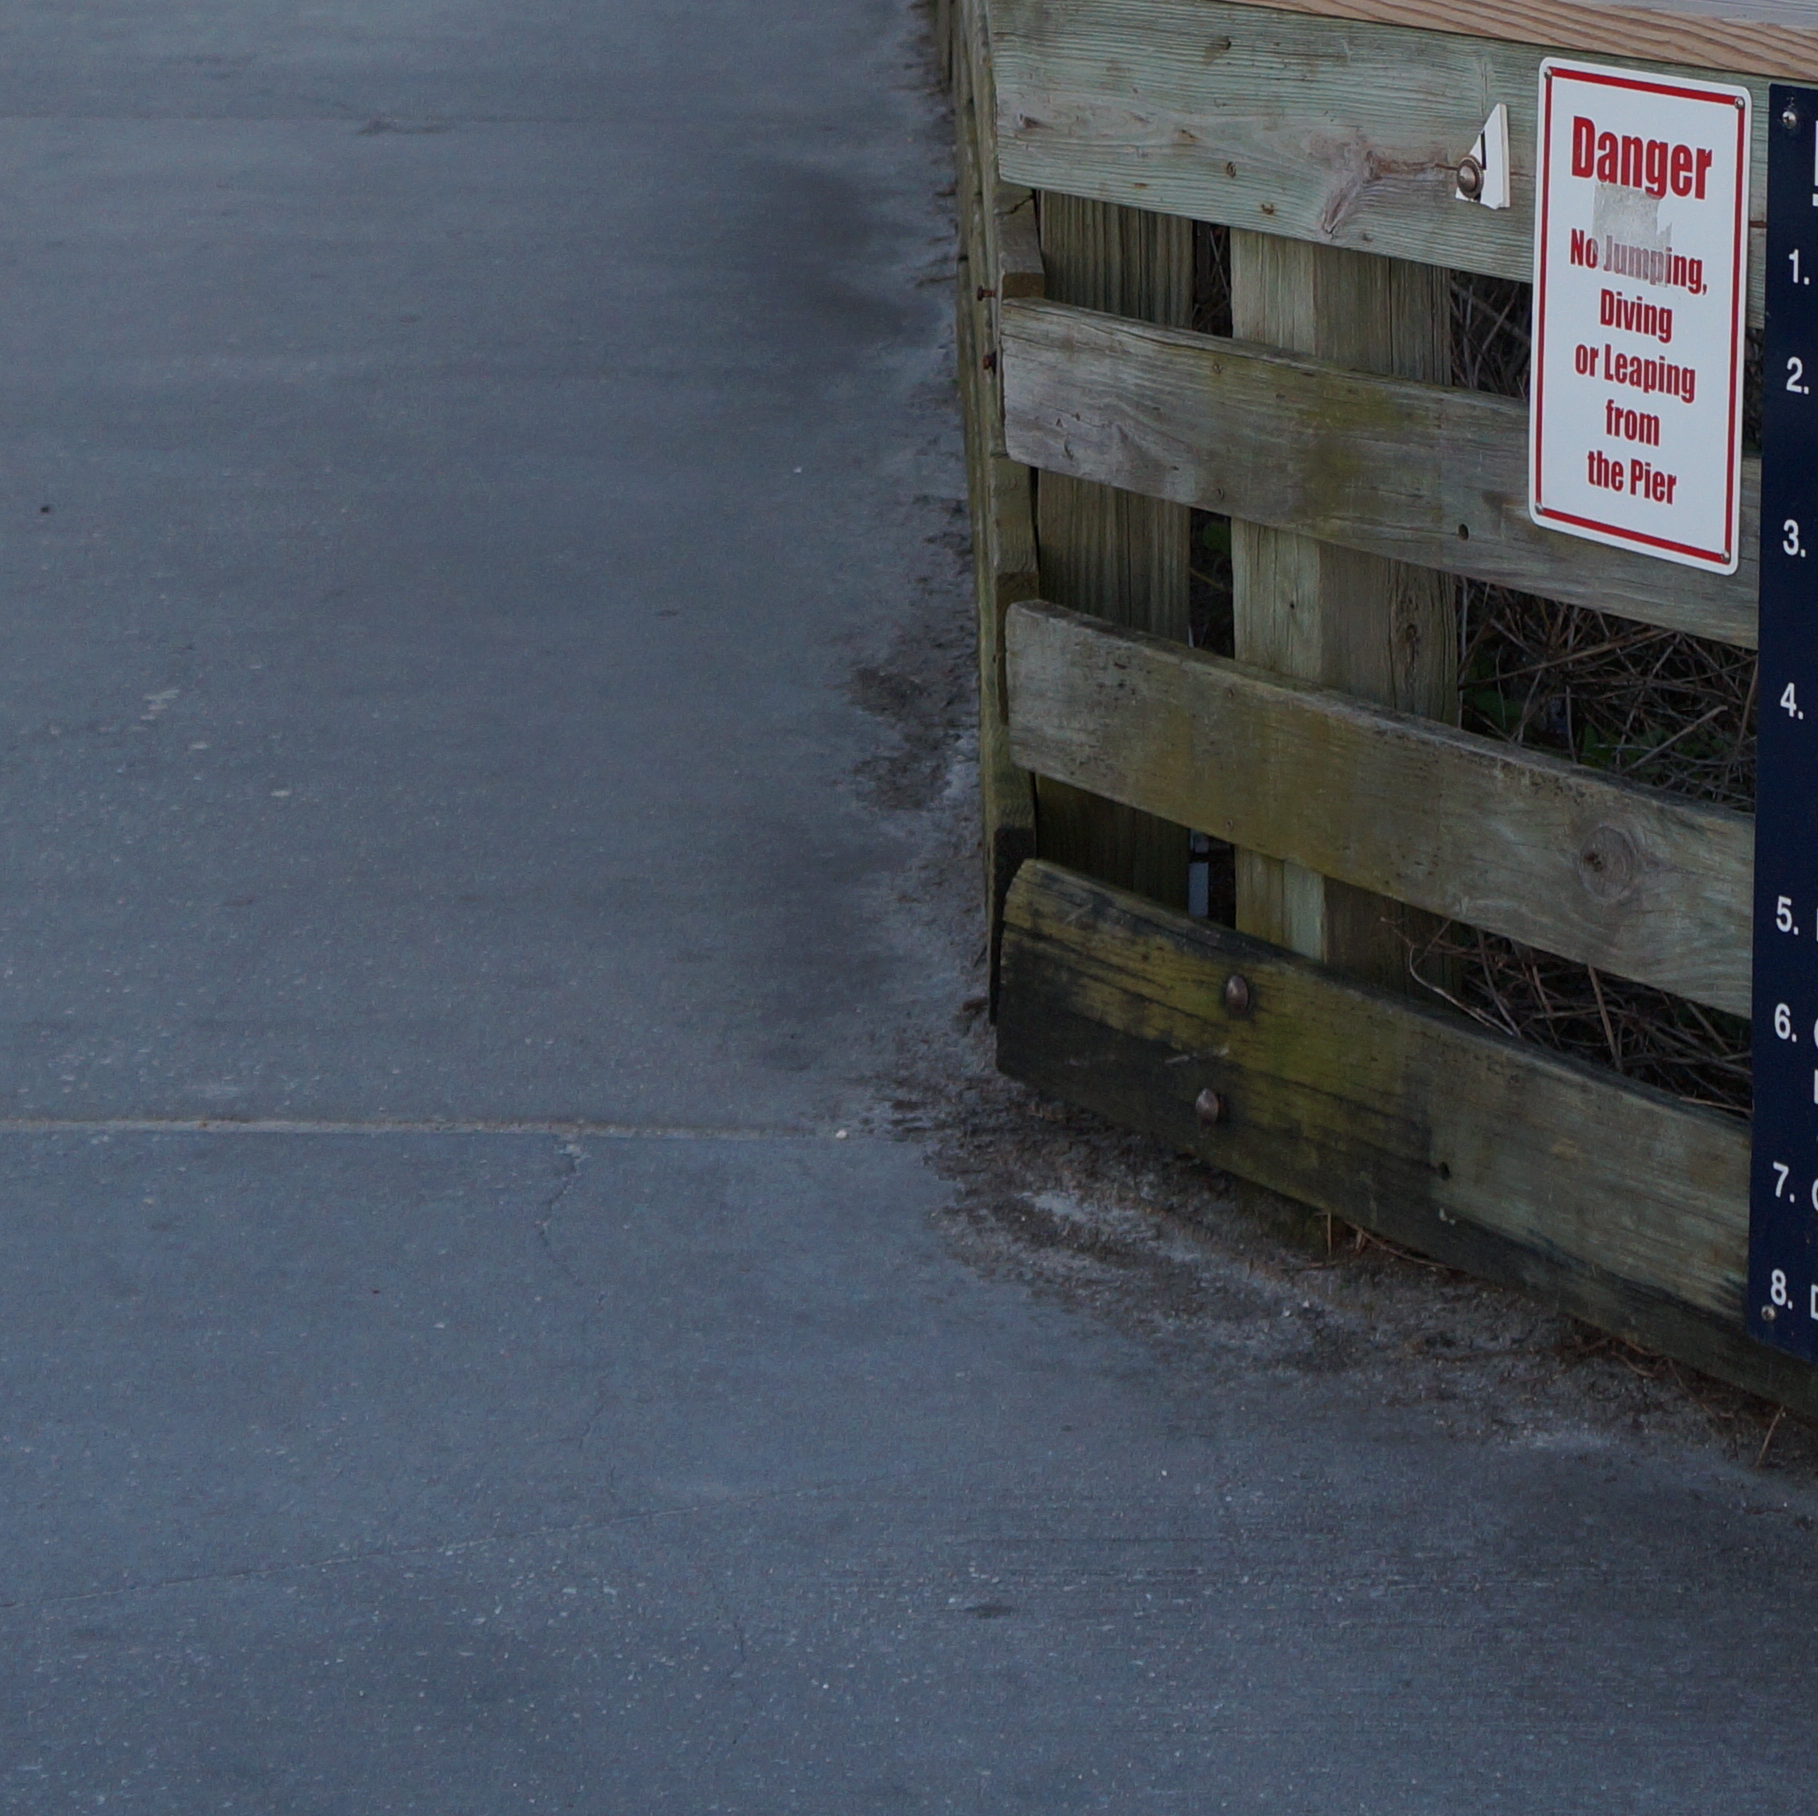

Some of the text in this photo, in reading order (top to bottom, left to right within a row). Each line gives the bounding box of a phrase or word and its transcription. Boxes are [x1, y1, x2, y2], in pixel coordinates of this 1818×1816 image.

[1572, 117, 1712, 199] Danger
[1570, 227, 1707, 295] No Jumping,
[1789, 249, 1809, 284] 1.
[1601, 289, 1672, 343] Diving
[1575, 344, 1695, 403] or Leaping
[1786, 357, 1809, 394] 2.
[1606, 400, 1659, 445] from
[1587, 451, 1676, 503] the Pier
[1783, 520, 1805, 557] 3.
[1781, 683, 1803, 719] 4.
[1776, 896, 1798, 935] 5.
[1775, 1004, 1796, 1042] 6.
[1773, 1162, 1794, 1202] 7.
[1771, 1270, 1792, 1309] 8.
